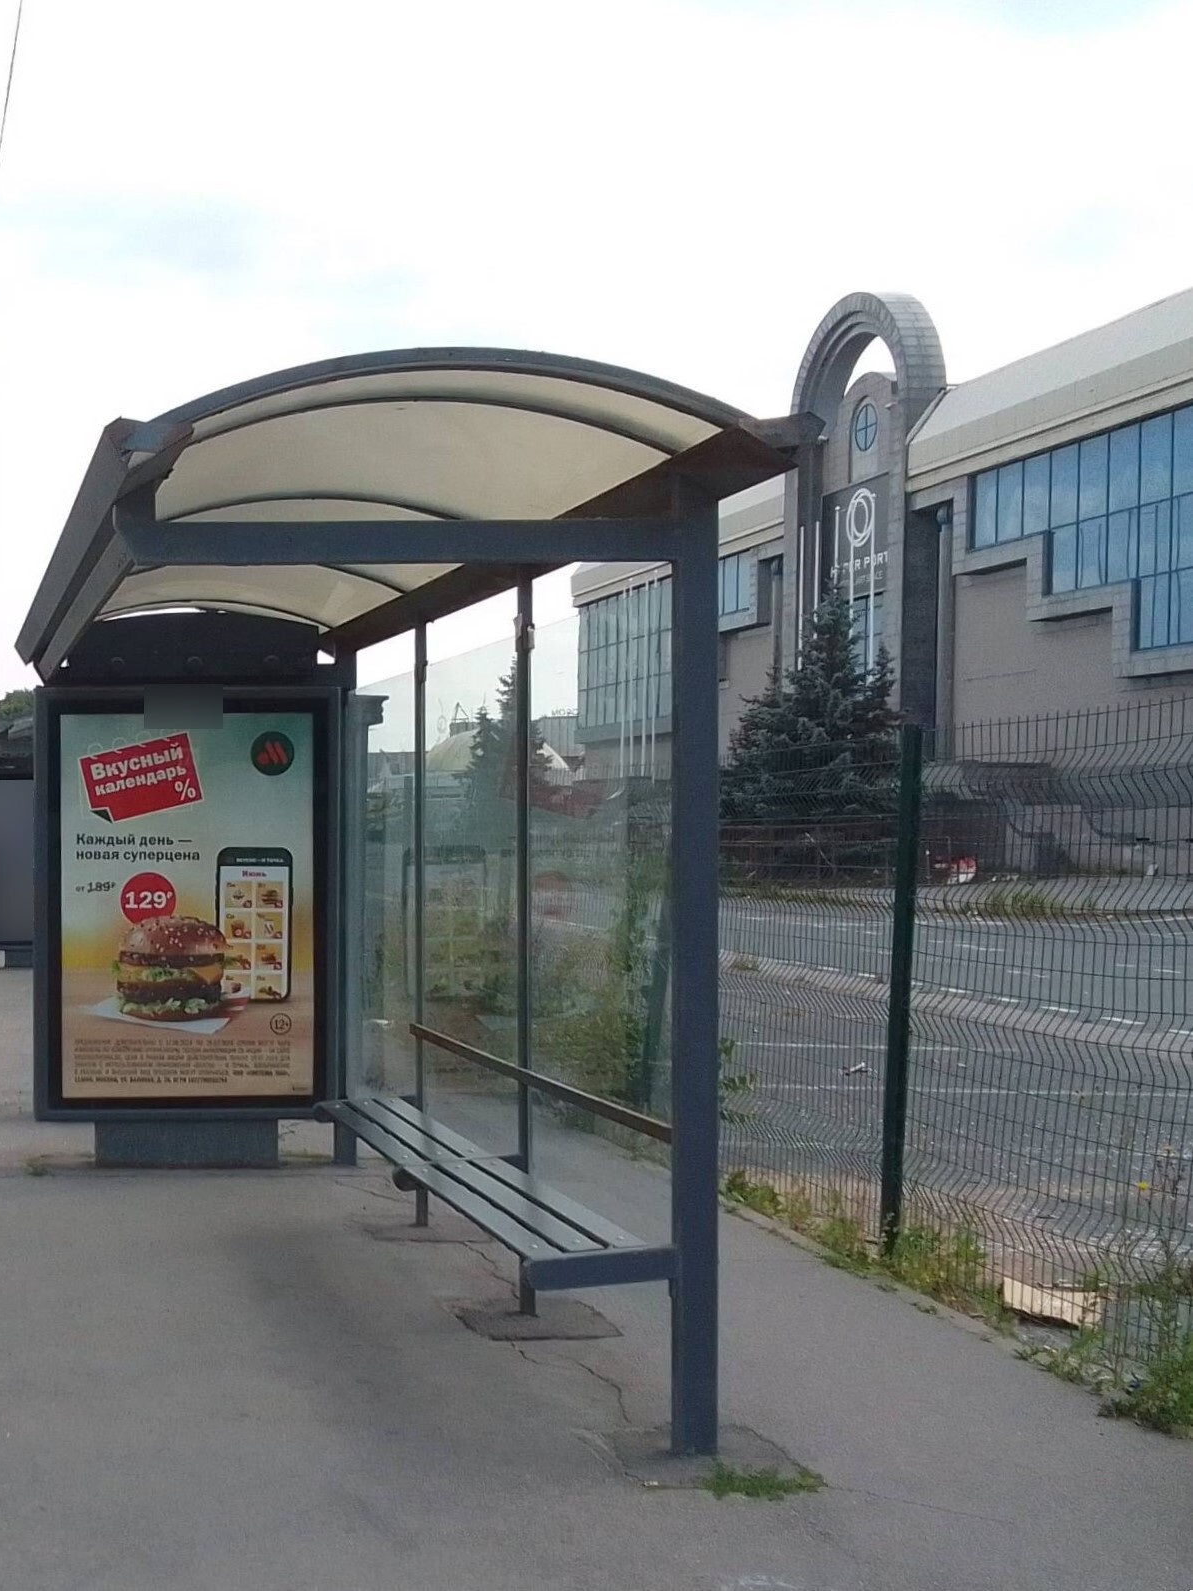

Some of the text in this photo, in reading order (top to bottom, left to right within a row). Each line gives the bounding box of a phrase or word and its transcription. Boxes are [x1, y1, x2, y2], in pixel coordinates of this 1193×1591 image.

[90, 742, 184, 780] Вкусный
[94, 765, 187, 796] календарь
[174, 778, 196, 801] %
[76, 833, 135, 846] Каждый
[139, 836, 174, 847] день
[76, 851, 200, 862] новая суперцена
[275, 1018, 289, 1030] 12+
